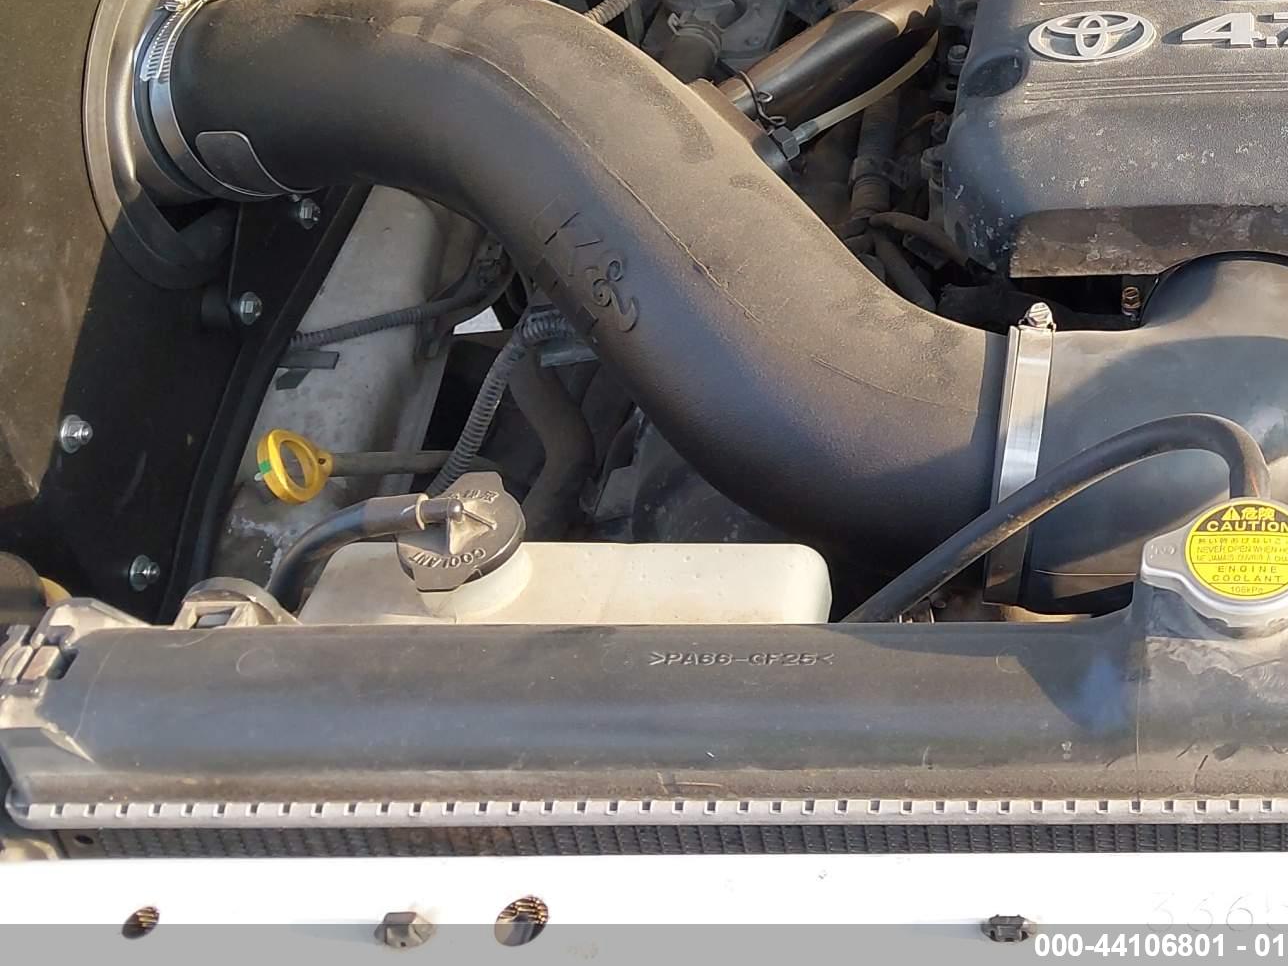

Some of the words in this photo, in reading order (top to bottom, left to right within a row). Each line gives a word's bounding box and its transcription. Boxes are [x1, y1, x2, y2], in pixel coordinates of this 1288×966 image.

[1240, 506, 1277, 521] 危険
[1196, 544, 1227, 554] NEVER
[1227, 545, 1252, 554] OPEN
[1252, 546, 1279, 554] WHEN
[409, 547, 487, 569] COOLANT
[1217, 565, 1278, 574] ENGINE
[1212, 574, 1284, 583] COOLANT
